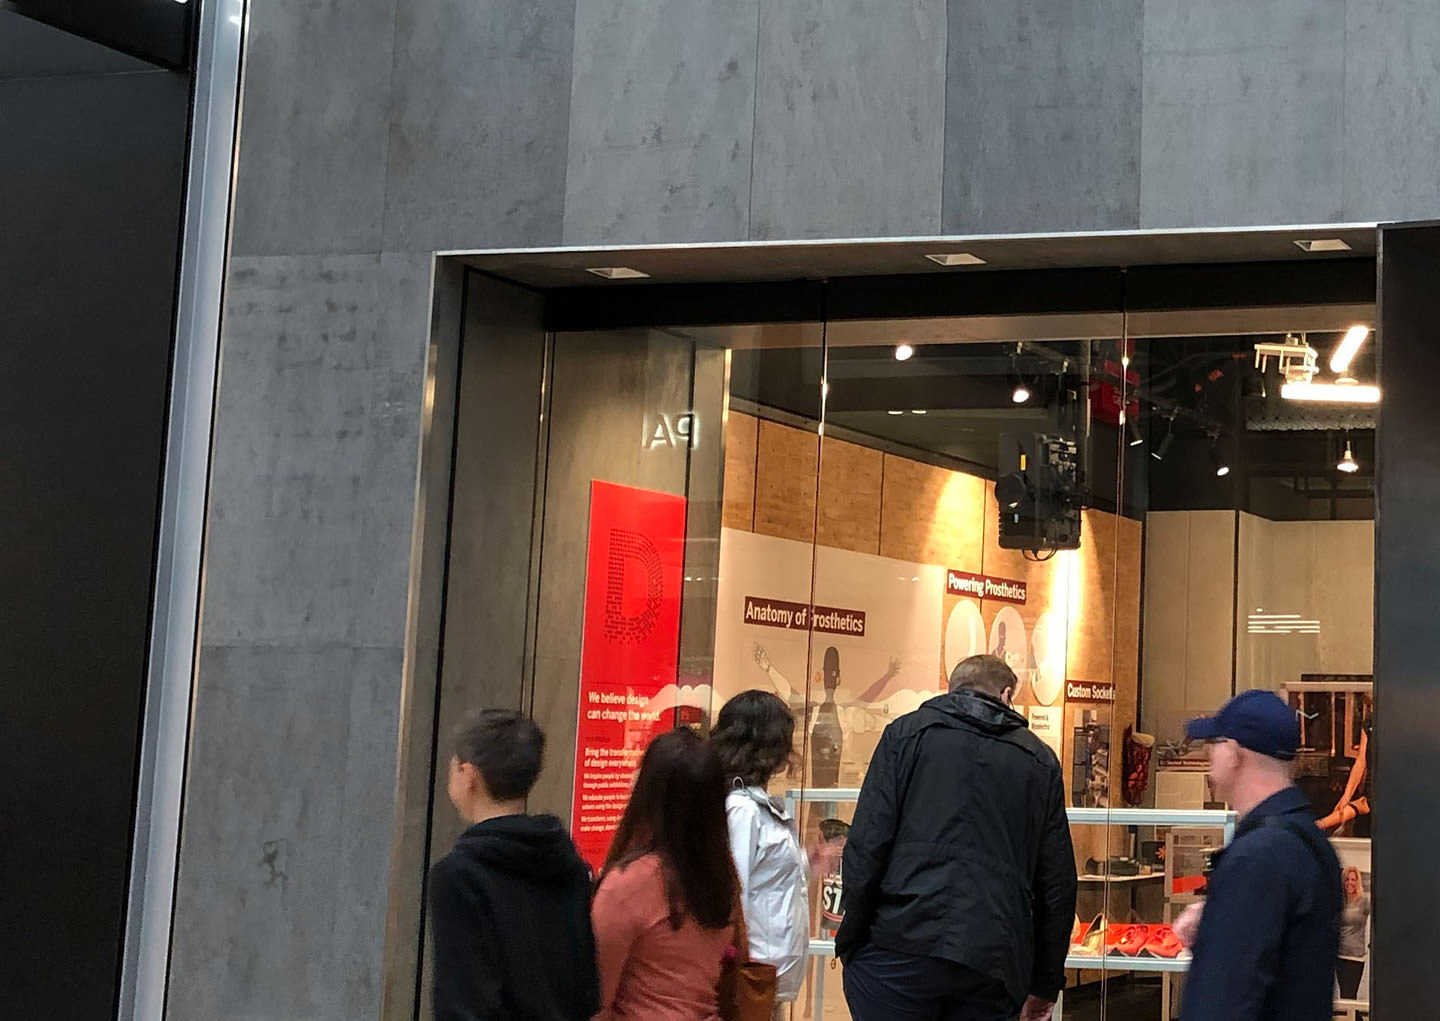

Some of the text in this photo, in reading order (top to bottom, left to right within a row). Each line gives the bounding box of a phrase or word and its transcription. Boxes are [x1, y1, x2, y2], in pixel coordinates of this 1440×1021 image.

[948, 573, 1025, 600] Powering Prosthetics
[746, 601, 864, 632] Anatomy of rosthetics
[1067, 683, 1091, 698] Custom
[588, 691, 648, 707] We believe design
[587, 709, 600, 720] can
[602, 708, 627, 722] change
[628, 710, 640, 720] the
